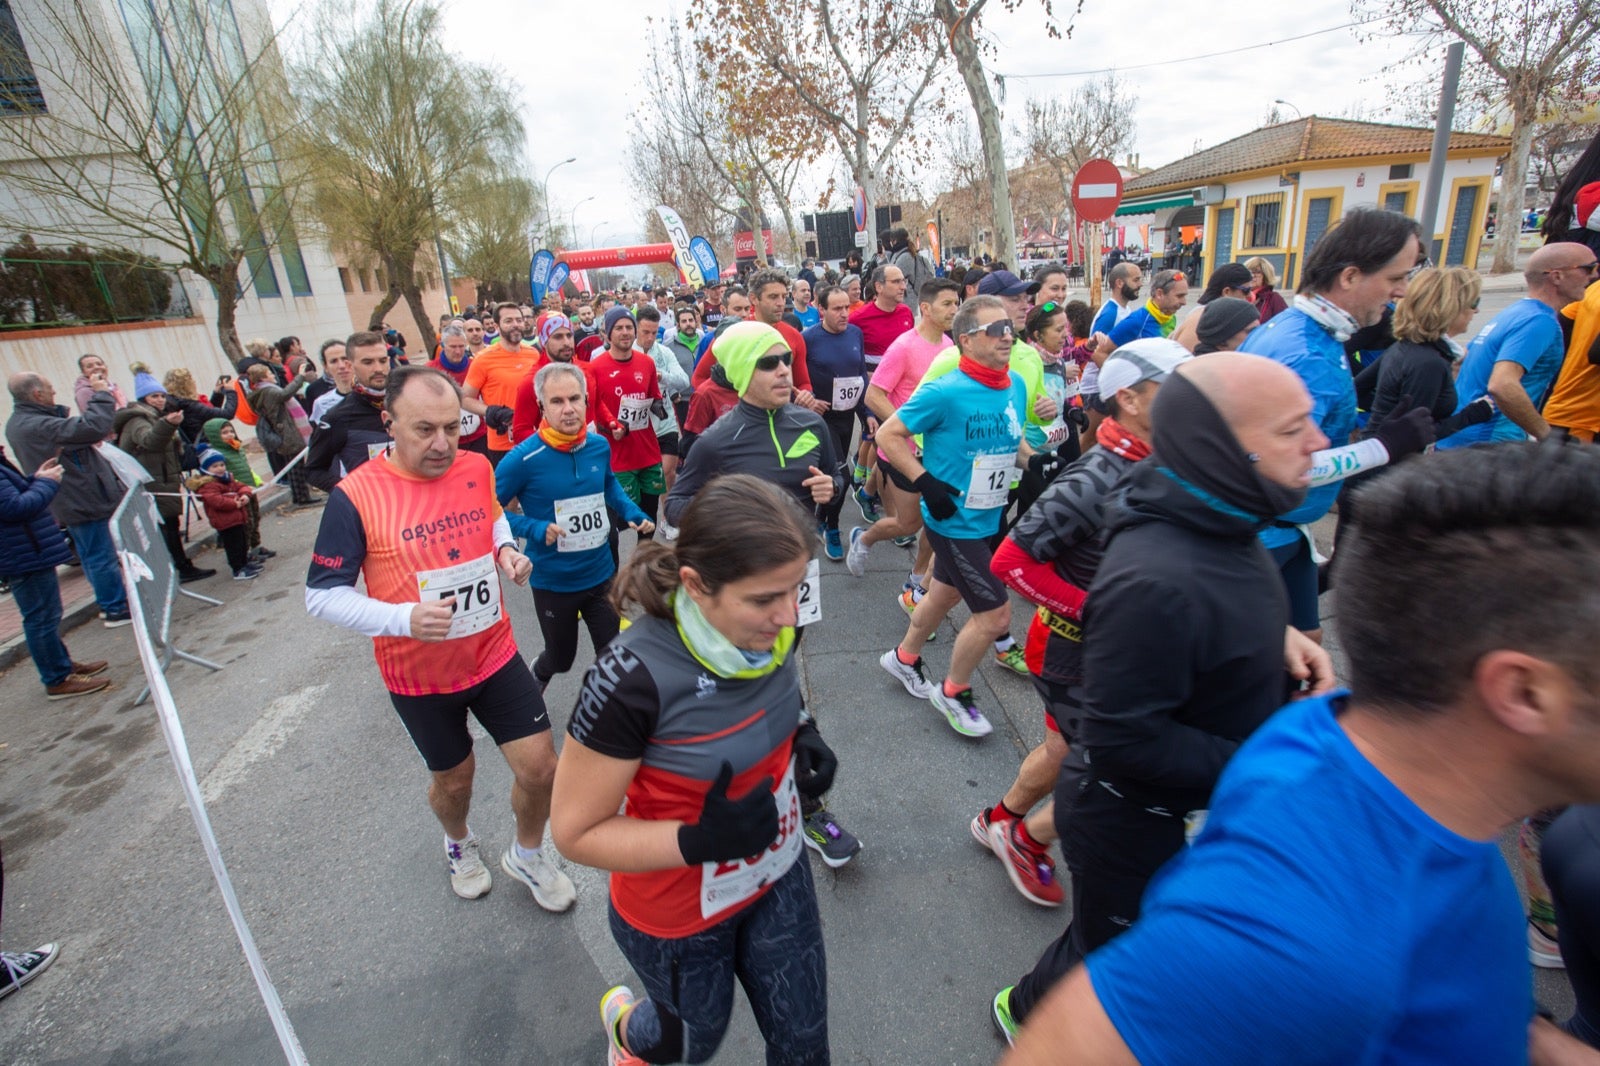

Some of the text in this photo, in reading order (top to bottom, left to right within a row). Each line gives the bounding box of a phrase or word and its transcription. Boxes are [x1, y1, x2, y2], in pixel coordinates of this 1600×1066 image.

[840, 387, 860, 400] 367
[621, 408, 648, 421] 3113
[1048, 427, 1068, 443] 2001
[988, 470, 1005, 490] 12
[402, 508, 486, 541] agustinos
[569, 511, 603, 534] 308
[421, 525, 481, 548] GRANADA
[569, 643, 641, 743] ATARFE
